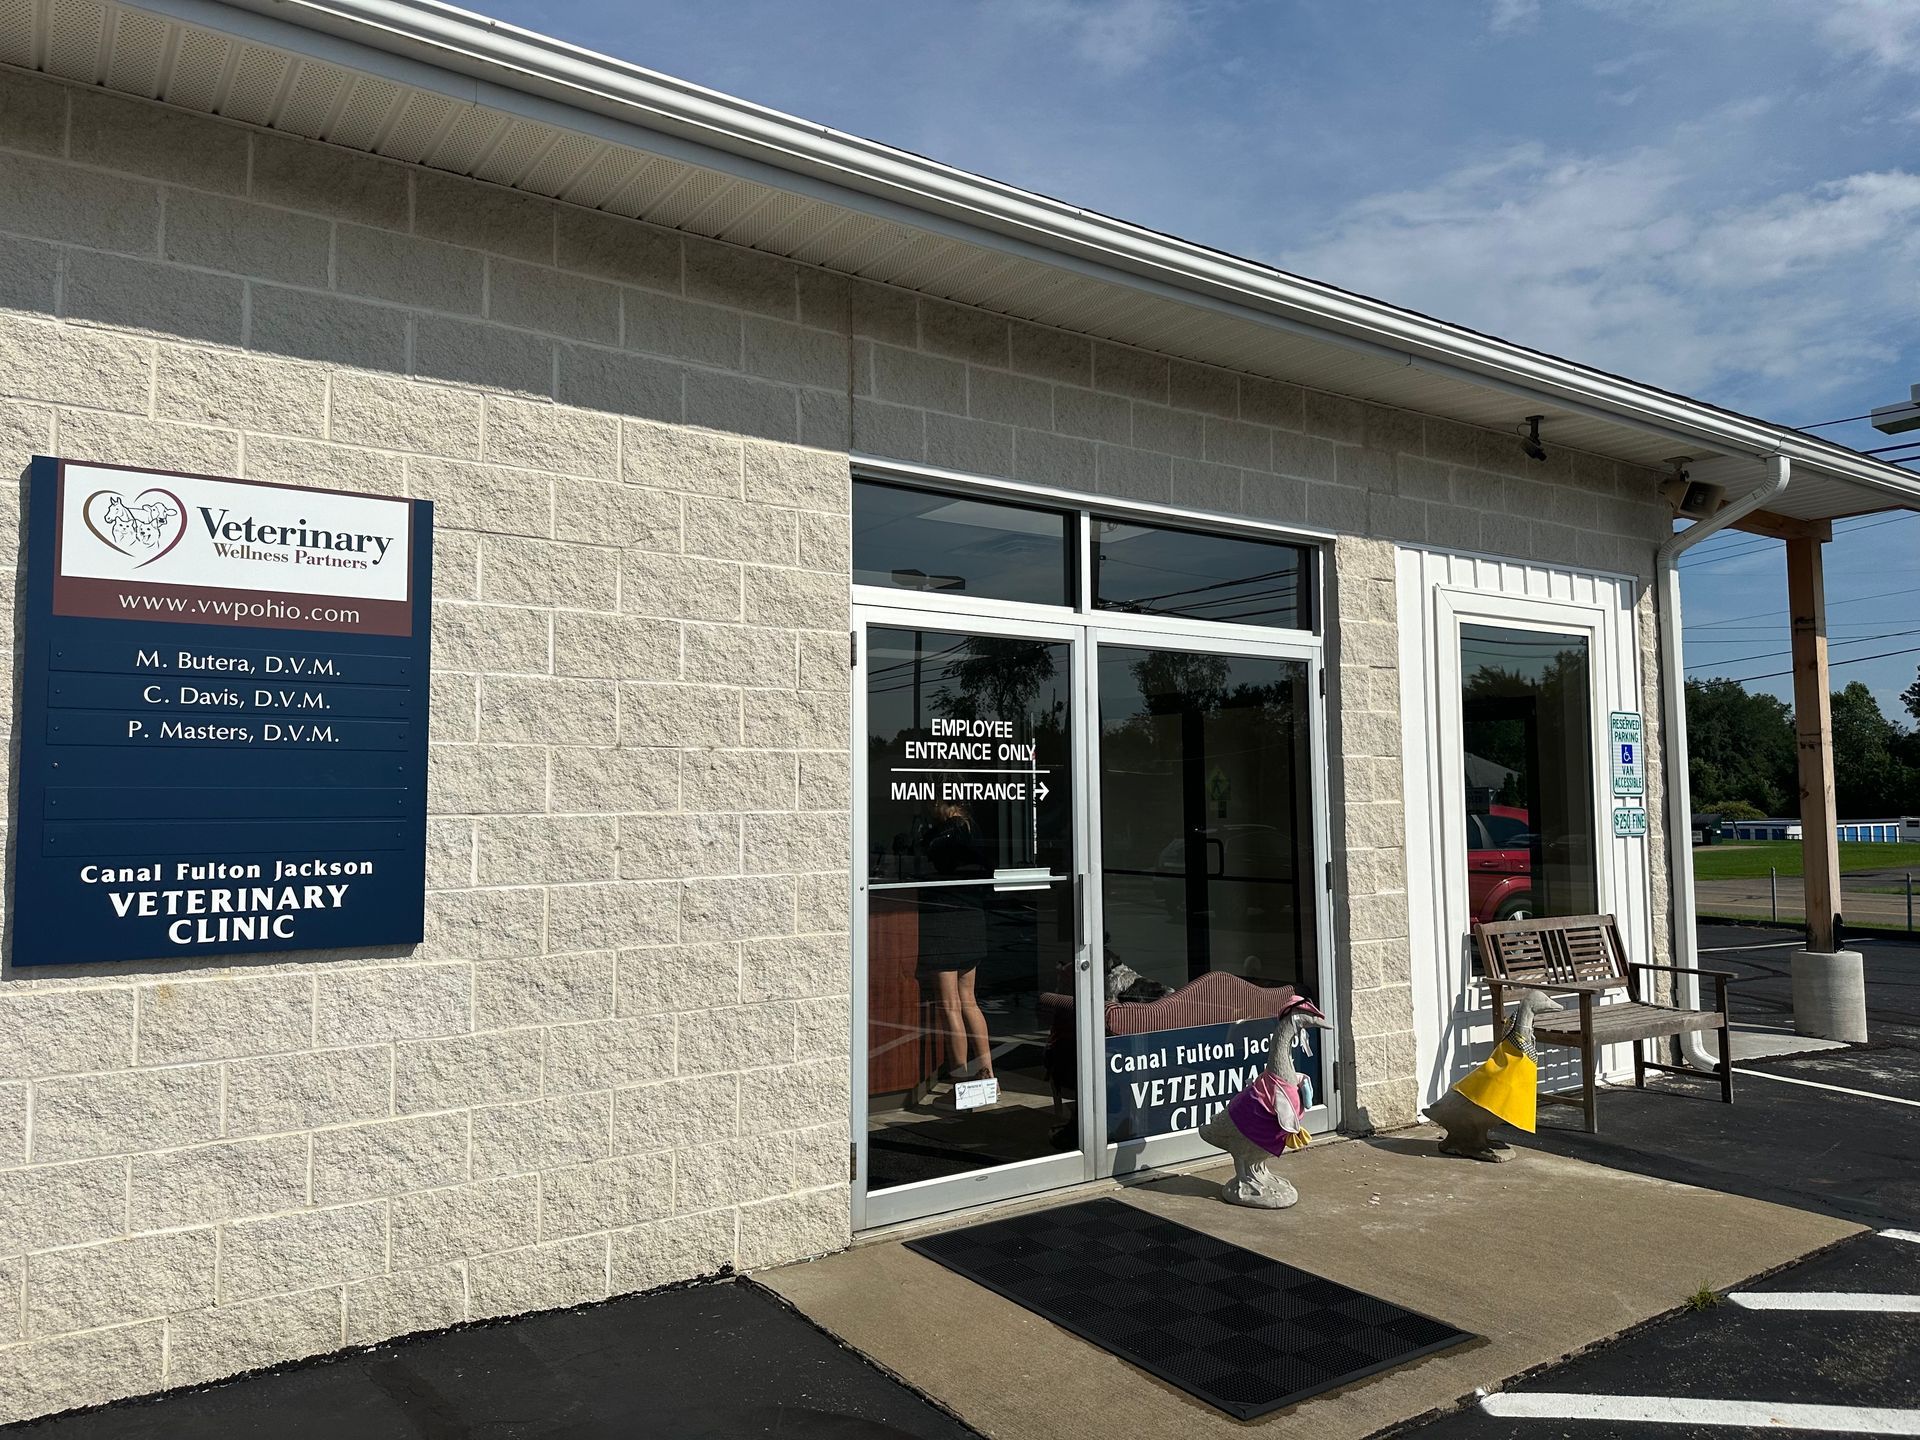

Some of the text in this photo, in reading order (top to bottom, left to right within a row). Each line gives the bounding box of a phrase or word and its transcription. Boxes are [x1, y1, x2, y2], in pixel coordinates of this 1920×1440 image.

[197, 507, 394, 565] Veterinary
[213, 542, 368, 570] Wellness Partners
[118, 593, 361, 624] www.vwpohio.com
[136, 650, 342, 677] M. Butera, D.V.M.
[143, 685, 332, 709] C. Davis, D.V.M.
[128, 720, 341, 743] P. Masters, D.V.M.
[931, 718, 1013, 738] EMPLOYEE
[1612, 719, 1640, 730] RESERVED
[1614, 731, 1639, 743] PARKING
[905, 741, 1036, 761] ENTRANCE ONLY
[1615, 777, 1642, 788] ACCESSIBLE
[1622, 766, 1634, 776] VAN
[891, 782, 1026, 801] MAIN ENTRANCE
[1614, 813, 1646, 829] $250 FINE
[80, 860, 374, 884] Canal Fulton Jackson
[108, 885, 349, 917] VETERINARY
[168, 915, 294, 944] CLINIC
[1110, 1047, 1167, 1074] Canal
[1176, 1042, 1234, 1066] Fulton
[1130, 1059, 1294, 1109] VETERINA
